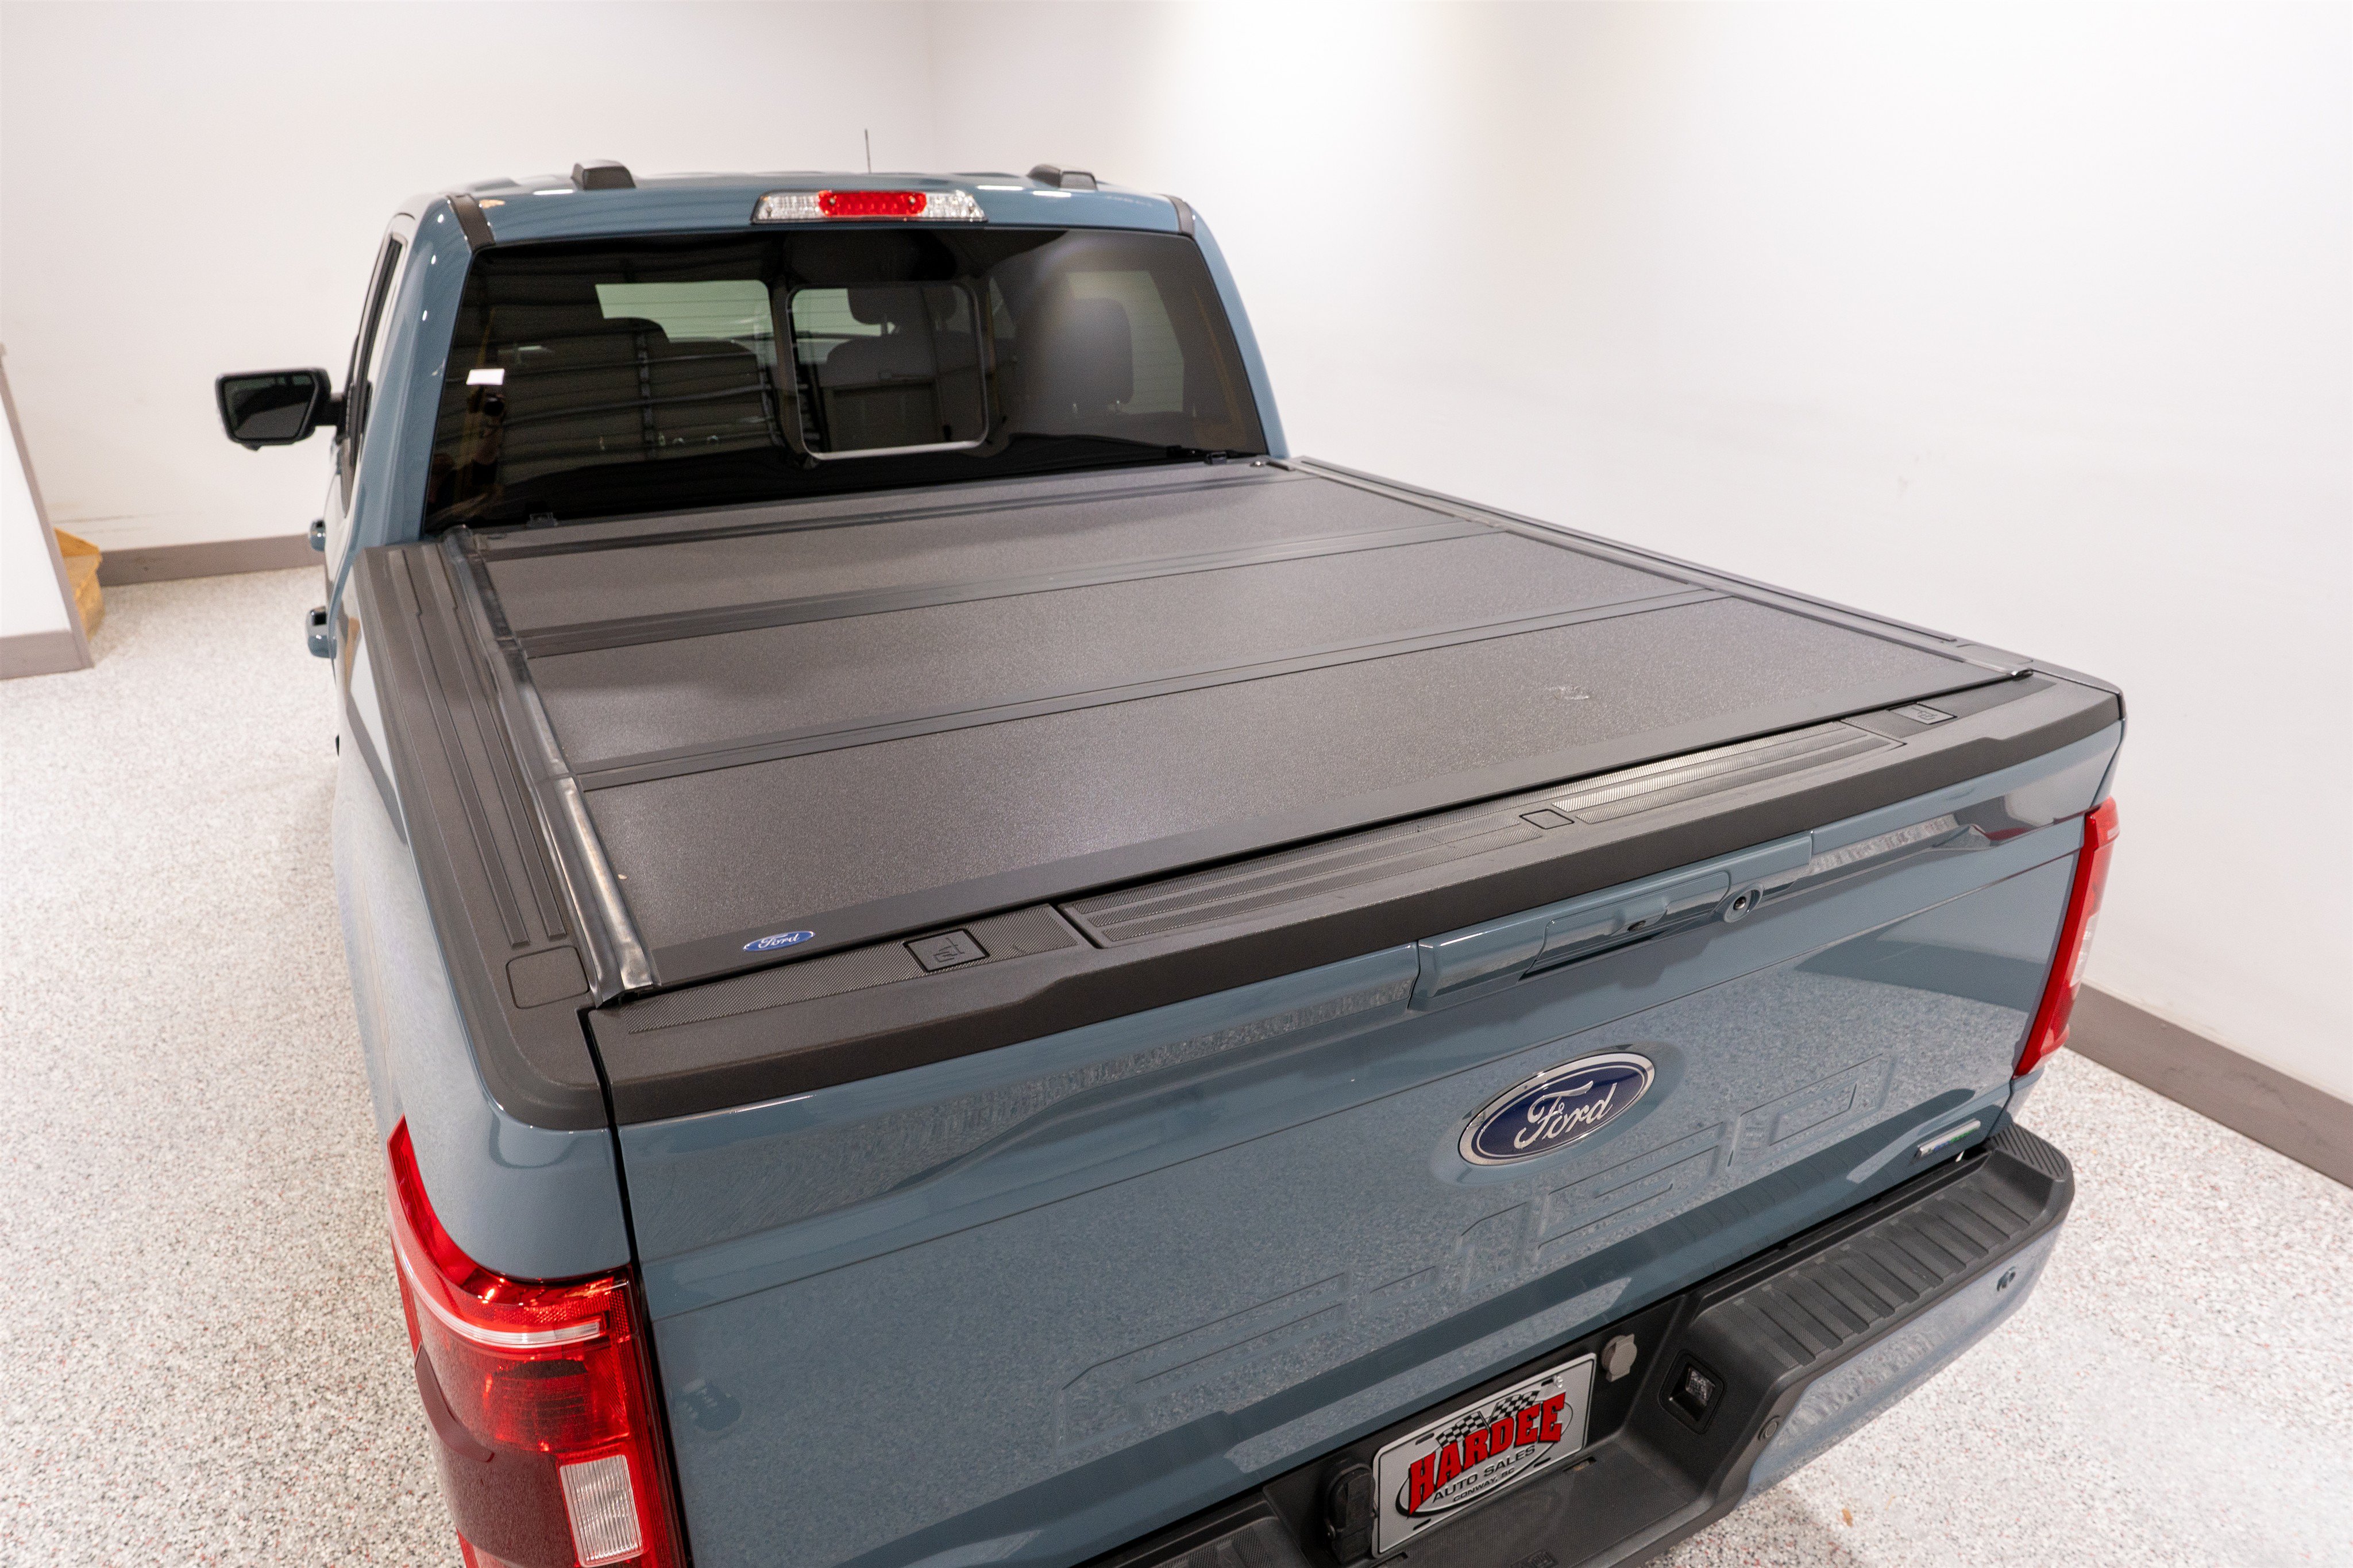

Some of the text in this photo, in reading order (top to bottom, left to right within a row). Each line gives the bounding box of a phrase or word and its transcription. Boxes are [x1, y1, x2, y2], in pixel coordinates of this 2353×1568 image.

[758, 933, 800, 948] Ford
[1514, 1080, 1618, 1149] Ford
[1407, 1391, 1566, 1517] HARDEE
[1433, 1445, 1535, 1504] AUTO SALES
[1453, 1477, 1498, 1502] CONWAY,
